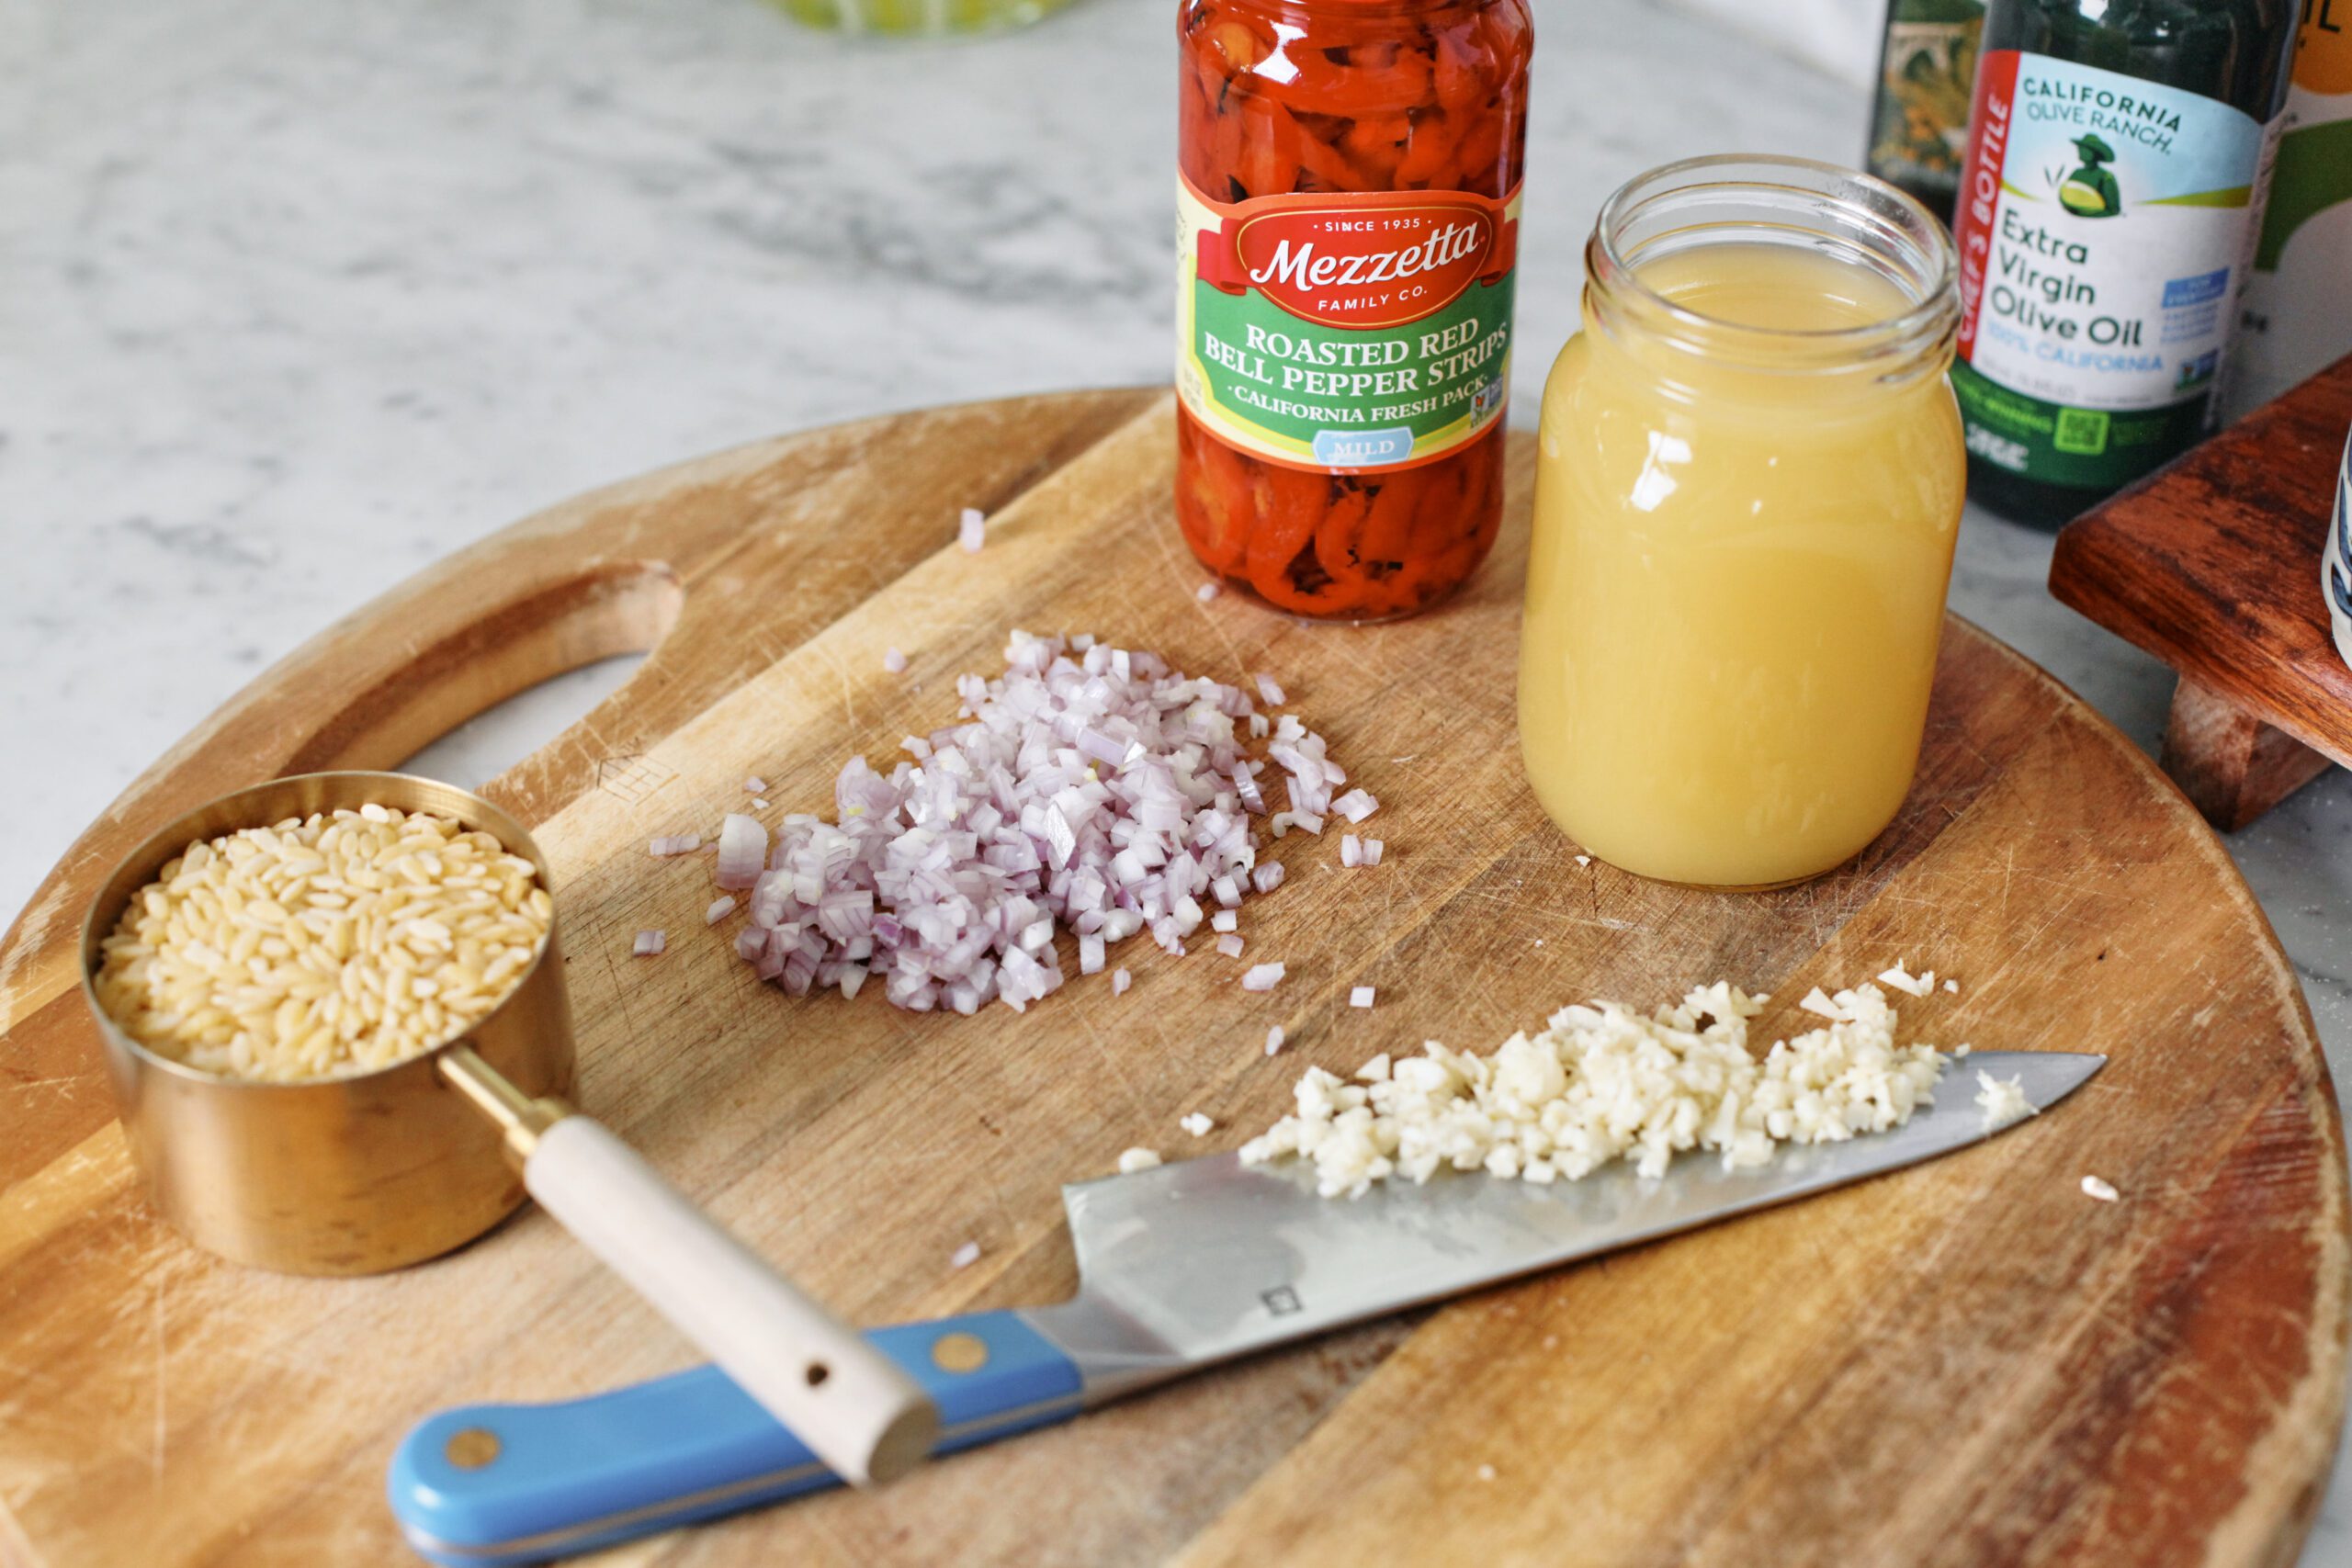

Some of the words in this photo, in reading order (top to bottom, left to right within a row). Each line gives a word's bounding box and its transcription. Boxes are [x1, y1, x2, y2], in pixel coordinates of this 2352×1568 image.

[2022, 77, 2183, 134] CALIFORNIA
[2026, 100, 2085, 127] OLIVE
[1972, 91, 2009, 227] BOTTLE
[1324, 220, 1374, 231] SINCE
[1383, 217, 1421, 231] 1935
[2003, 209, 2088, 265] Extra
[1250, 220, 1479, 292] Mezzetta
[1998, 246, 2096, 306] Virgin
[1317, 294, 1390, 311] FAMILY
[1398, 285, 1428, 301] CO.
[1991, 286, 2078, 339] Olive
[2088, 316, 2143, 347] Oil
[1204, 331, 1273, 386] BELL
[1282, 365, 1419, 397] PEPPER
[1427, 320, 1508, 387] STRIPS
[1245, 322, 1409, 367] ROASTED
[1419, 317, 1479, 359] RED
[2035, 342, 2163, 372] CALIFORNIA
[1234, 384, 1365, 423] CALIFORNIA
[1371, 391, 1437, 423] FRESH
[1442, 378, 1484, 412] PACK
[1333, 438, 1396, 457] MILD
